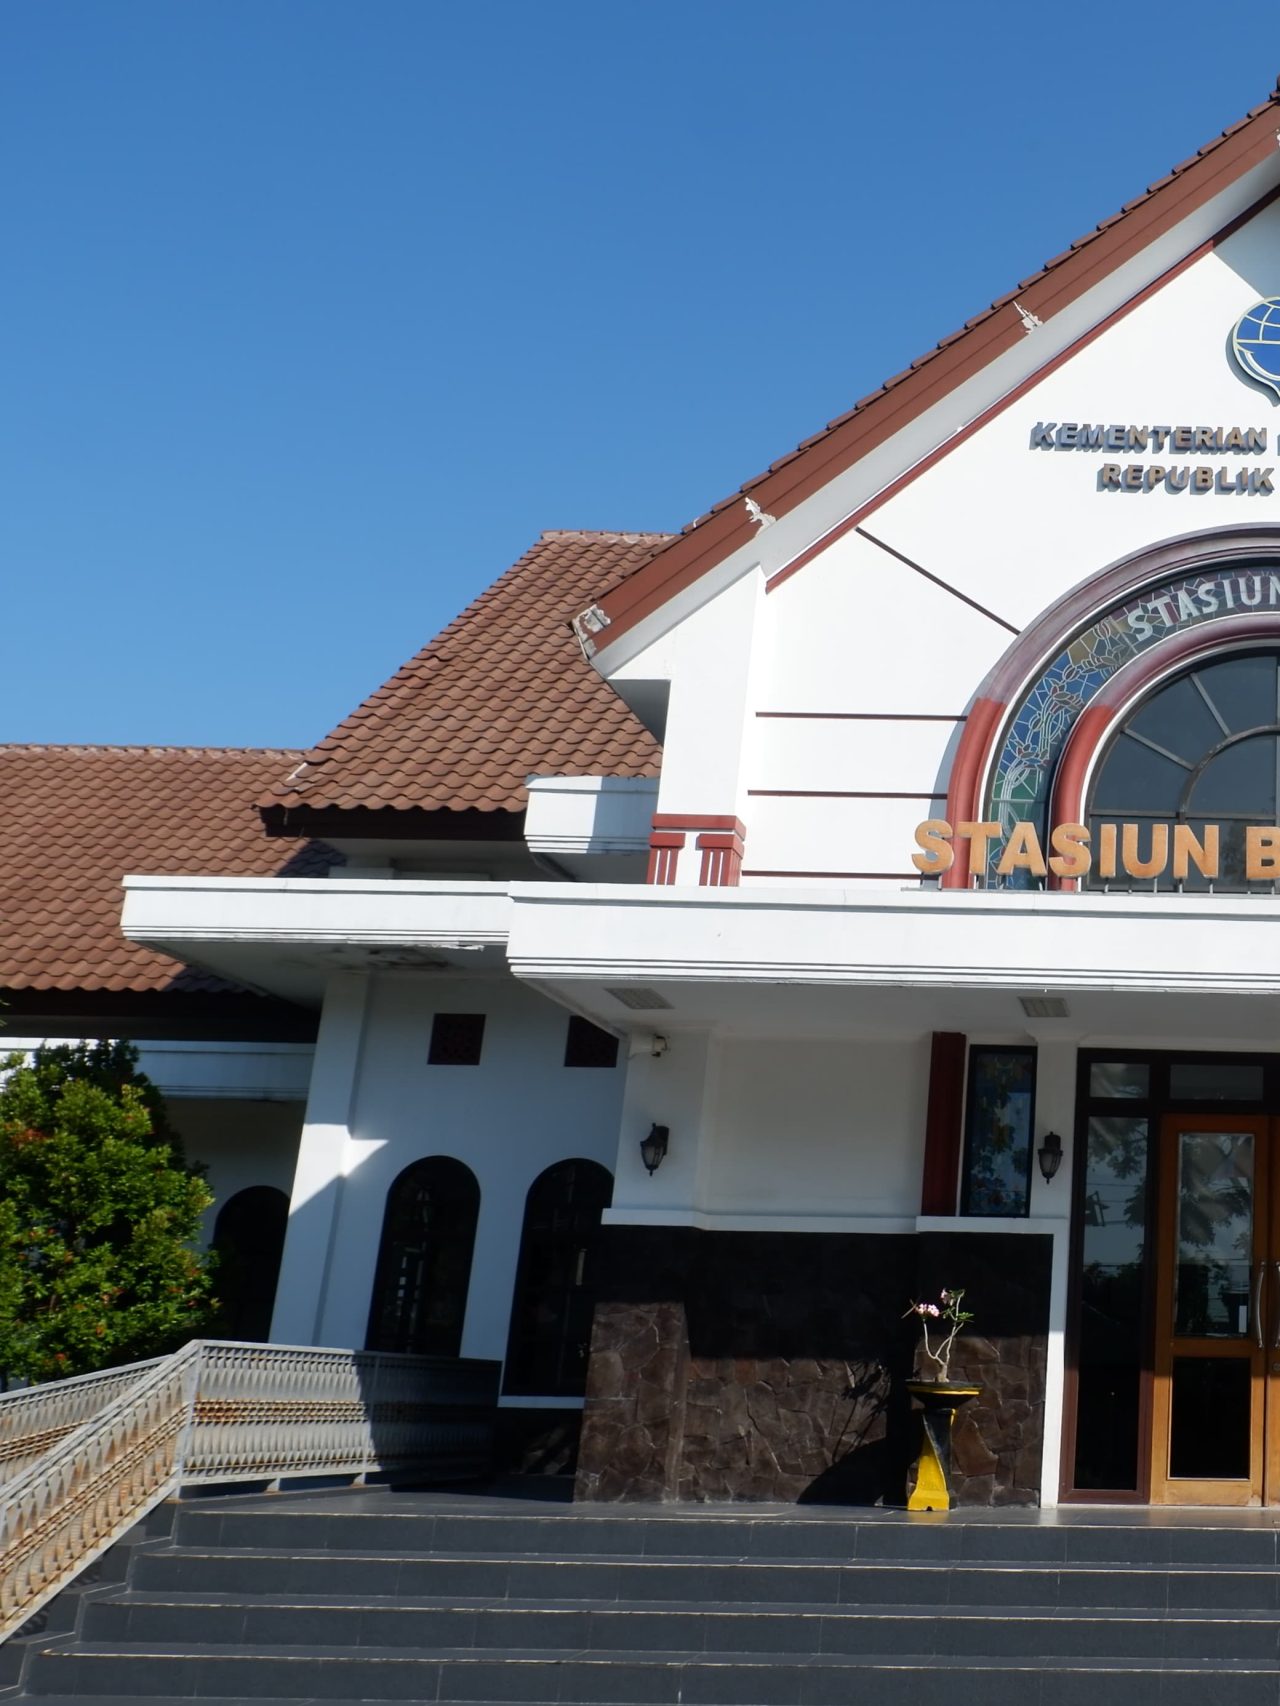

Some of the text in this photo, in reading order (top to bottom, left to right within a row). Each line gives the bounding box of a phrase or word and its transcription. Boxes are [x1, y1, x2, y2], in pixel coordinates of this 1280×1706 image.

[1032, 421, 1267, 451] KEMENTERIAN
[1101, 463, 1275, 492] REPUBLIK
[911, 819, 1220, 879] STASIUN
